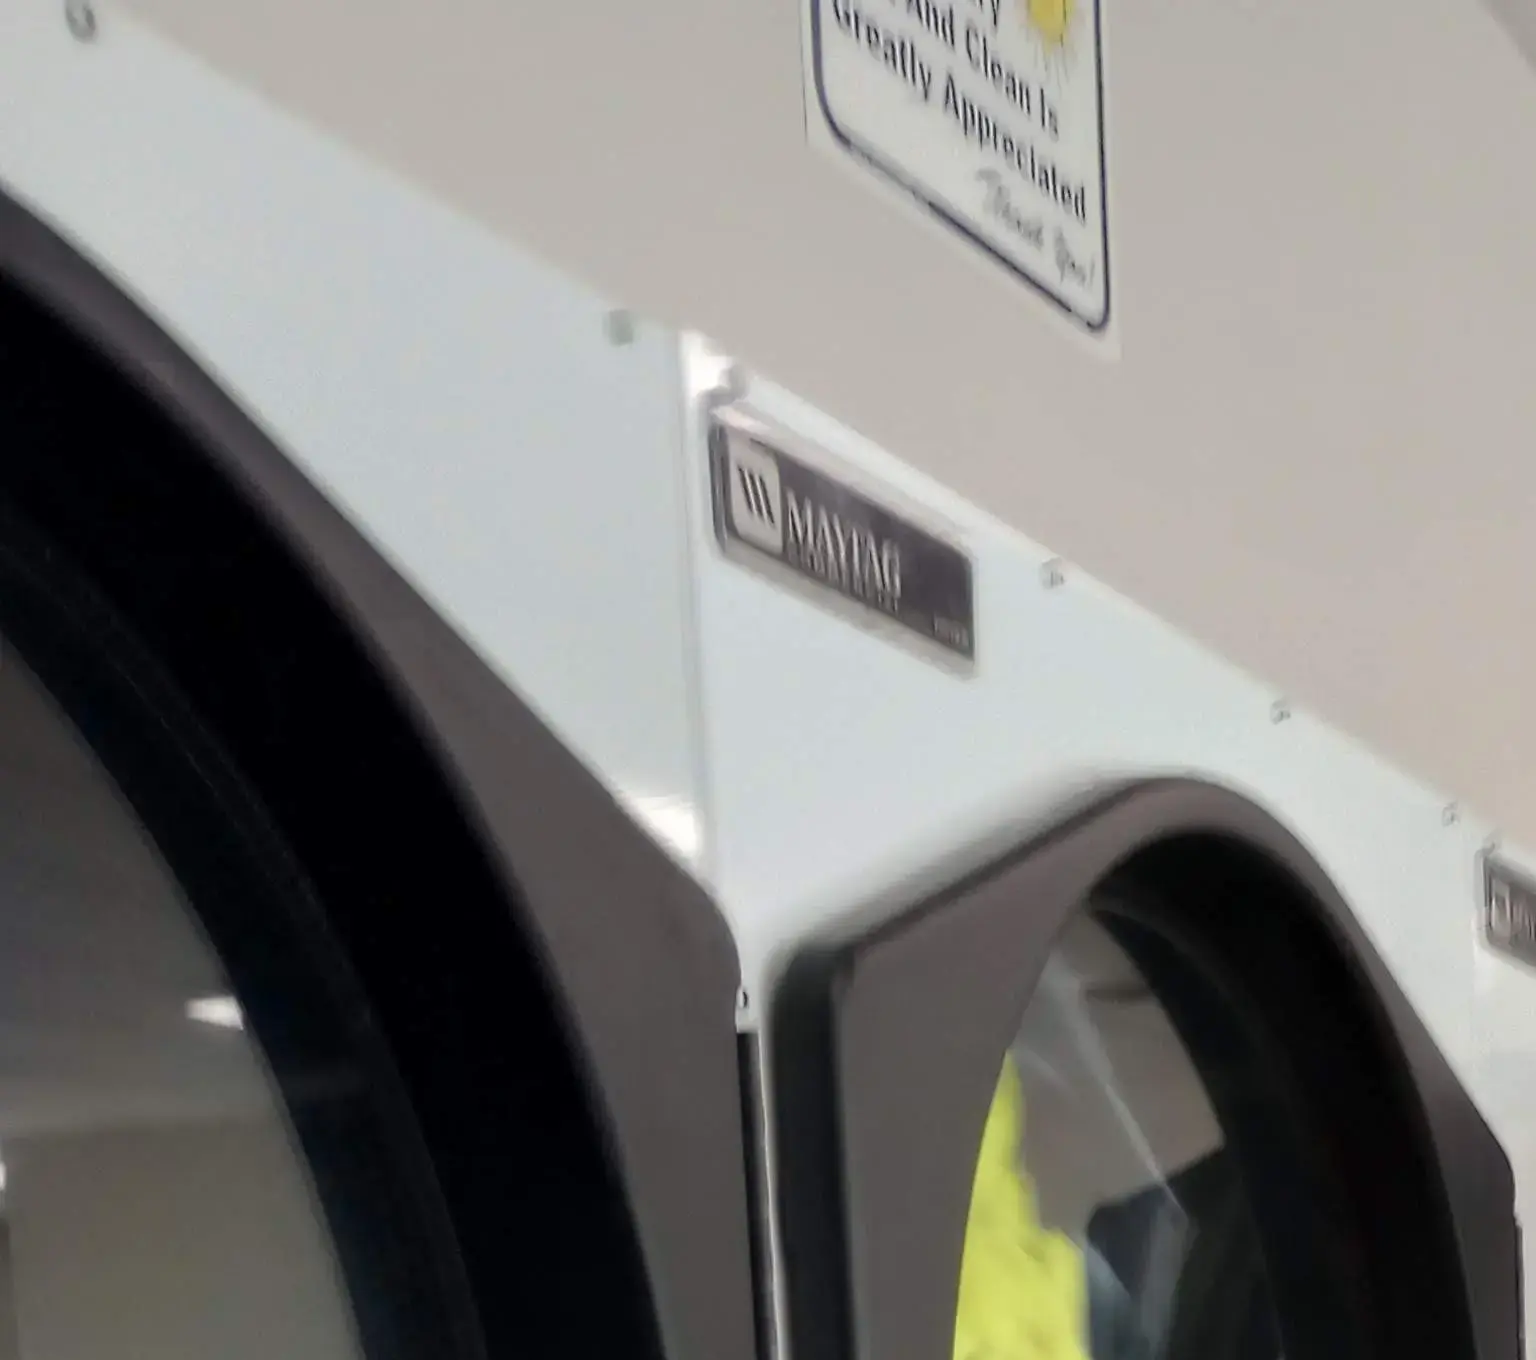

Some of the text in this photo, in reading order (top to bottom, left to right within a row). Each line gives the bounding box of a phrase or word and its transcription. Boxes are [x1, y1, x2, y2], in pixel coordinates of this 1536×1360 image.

[833, 0, 1086, 223] Greatly Appreciated
[964, 20, 1031, 118] Clean
[1039, 86, 1058, 138] Is
[786, 487, 901, 614] MAYTAG
